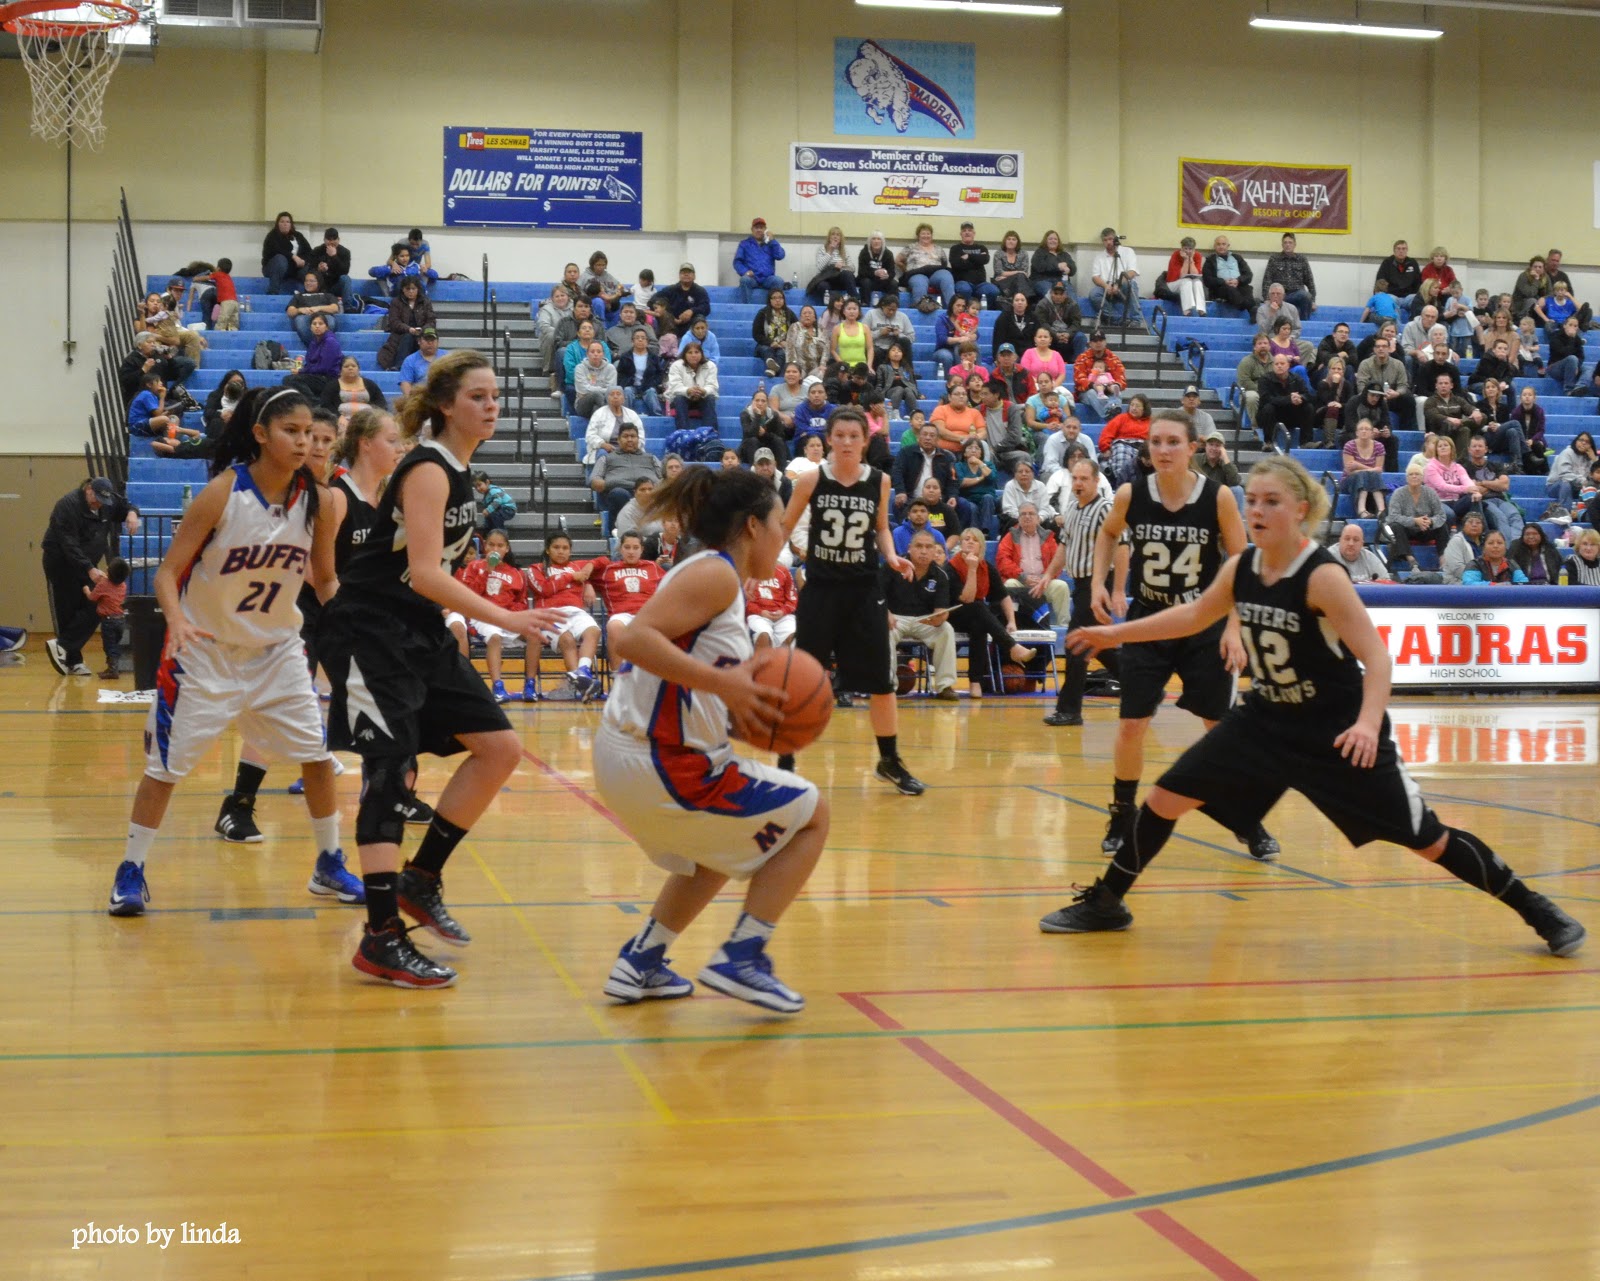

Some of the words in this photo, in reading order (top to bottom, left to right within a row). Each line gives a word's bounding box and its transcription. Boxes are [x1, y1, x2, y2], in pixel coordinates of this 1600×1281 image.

[913, 87, 959, 129] MADRAS
[466, 132, 483, 147] Tires
[500, 138, 527, 146] SCHWAB
[871, 150, 912, 160] Member
[914, 151, 927, 161] of
[928, 152, 944, 162] the
[818, 159, 856, 170] Oregon
[859, 160, 890, 170] School
[893, 161, 938, 172] Activities
[941, 163, 996, 174] Association
[449, 168, 513, 191] DOLLARS
[515, 173, 544, 191] FOR
[547, 175, 601, 191] POINTS!
[887, 176, 925, 189] OSAA
[882, 188, 908, 196] State
[448, 197, 455, 209] $
[544, 201, 551, 211] $
[875, 196, 939, 206] Championships
[1253, 208, 1281, 217] RESORT
[1292, 210, 1322, 219] CASINO
[817, 495, 875, 514] SISTERS
[820, 509, 870, 548] 32
[1135, 524, 1209, 544] SISTERS
[815, 545, 866, 563] OUTLAWS
[1142, 541, 1202, 587] 24
[614, 568, 649, 580] MADRAS
[236, 581, 282, 614] 21
[1438, 613, 1481, 621] WELCOME
[1483, 613, 1494, 621] TO
[1241, 626, 1298, 685] 12
[1430, 669, 1457, 678] HIGH
[1459, 669, 1501, 678] SCHOOL
